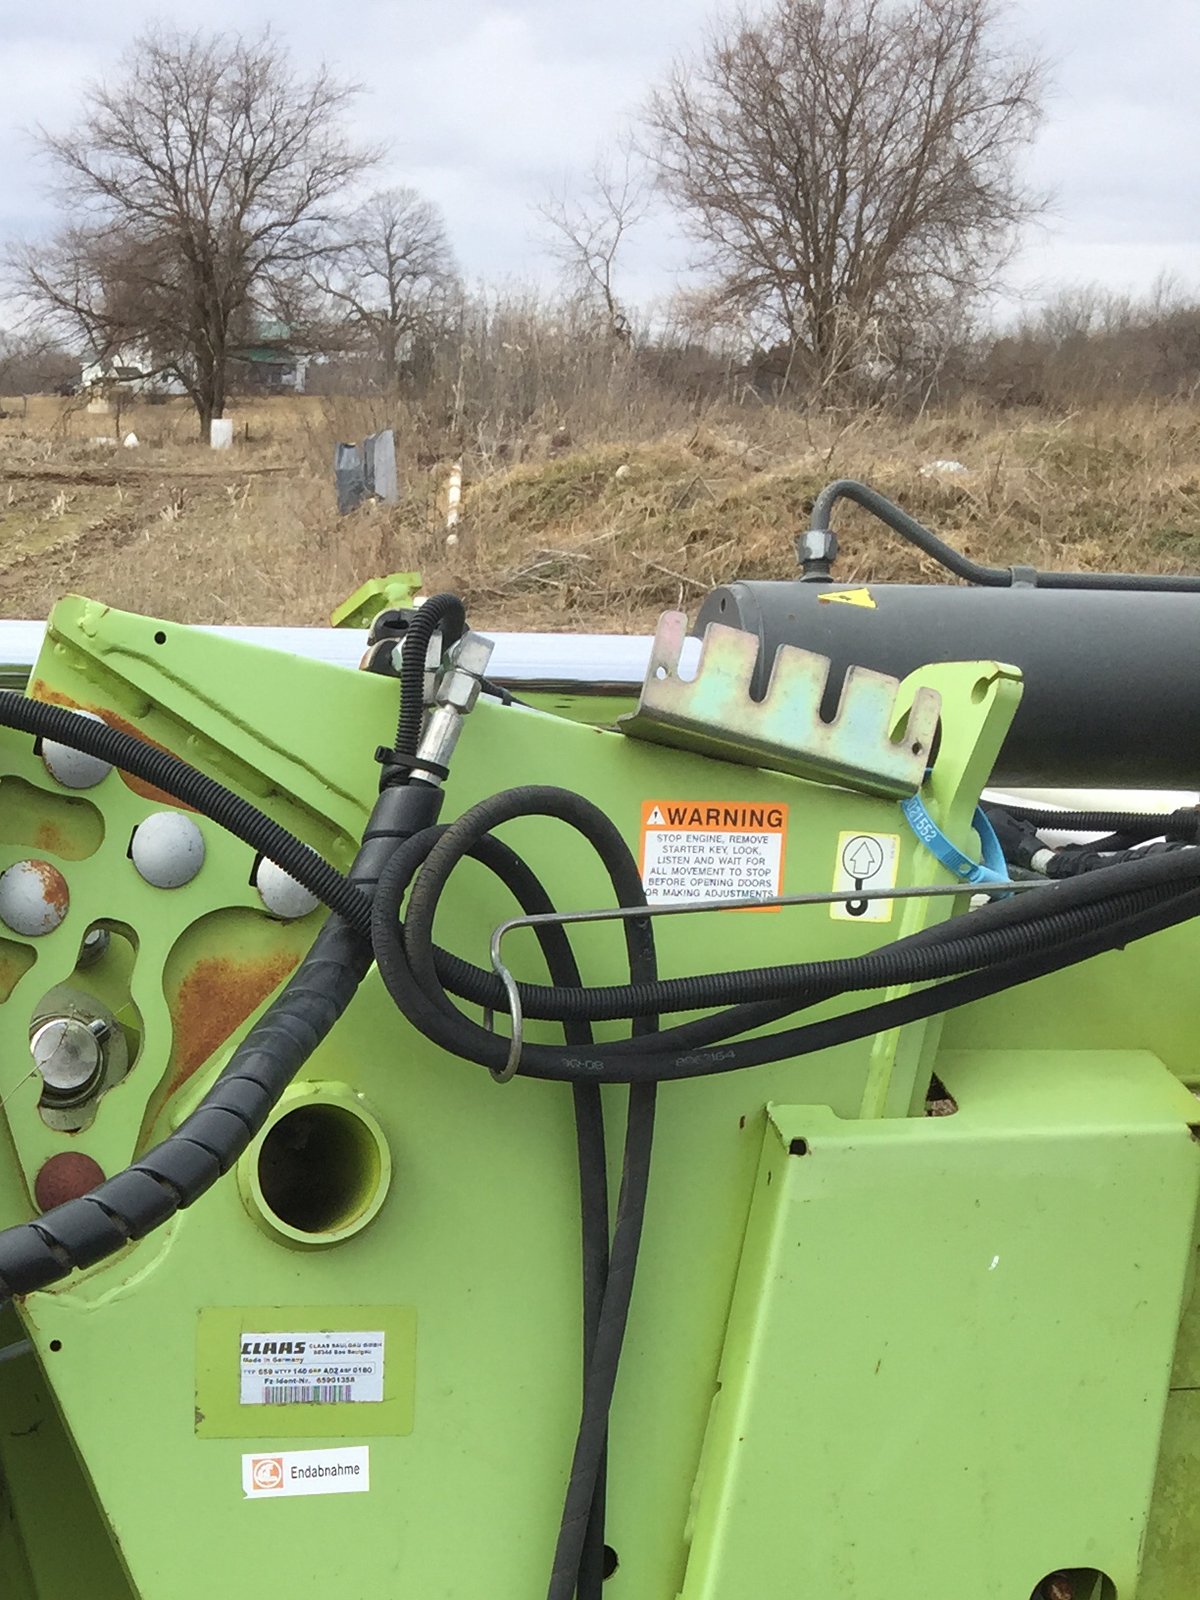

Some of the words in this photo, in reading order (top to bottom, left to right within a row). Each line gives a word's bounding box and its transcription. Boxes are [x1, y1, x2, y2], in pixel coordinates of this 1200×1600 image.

[667, 807, 783, 828] WARNING
[657, 834, 682, 843] STOP
[686, 834, 725, 844] ENGINE,
[729, 835, 769, 844] REMOVE
[662, 845, 705, 854] STARTER
[657, 856, 690, 865] LISTEN
[694, 856, 715, 865] AND
[718, 857, 742, 866] WAIT
[746, 857, 766, 866] FOR
[650, 867, 667, 875] ALL
[671, 867, 725, 876] MOVEMENT
[729, 868, 742, 876] TO
[746, 868, 772, 877] STOP
[648, 877, 686, 886] BEFORE
[689, 878, 734, 887] OPENING
[738, 878, 772, 888] DOORS
[645, 888, 659, 897] OR
[663, 888, 700, 897] MAKING
[705, 889, 774, 898] ADJUSTMENTS
[241, 1342, 306, 1355] CLAAS
[272, 1356, 304, 1364] Germany
[290, 1463, 360, 1479] Endabnahme
